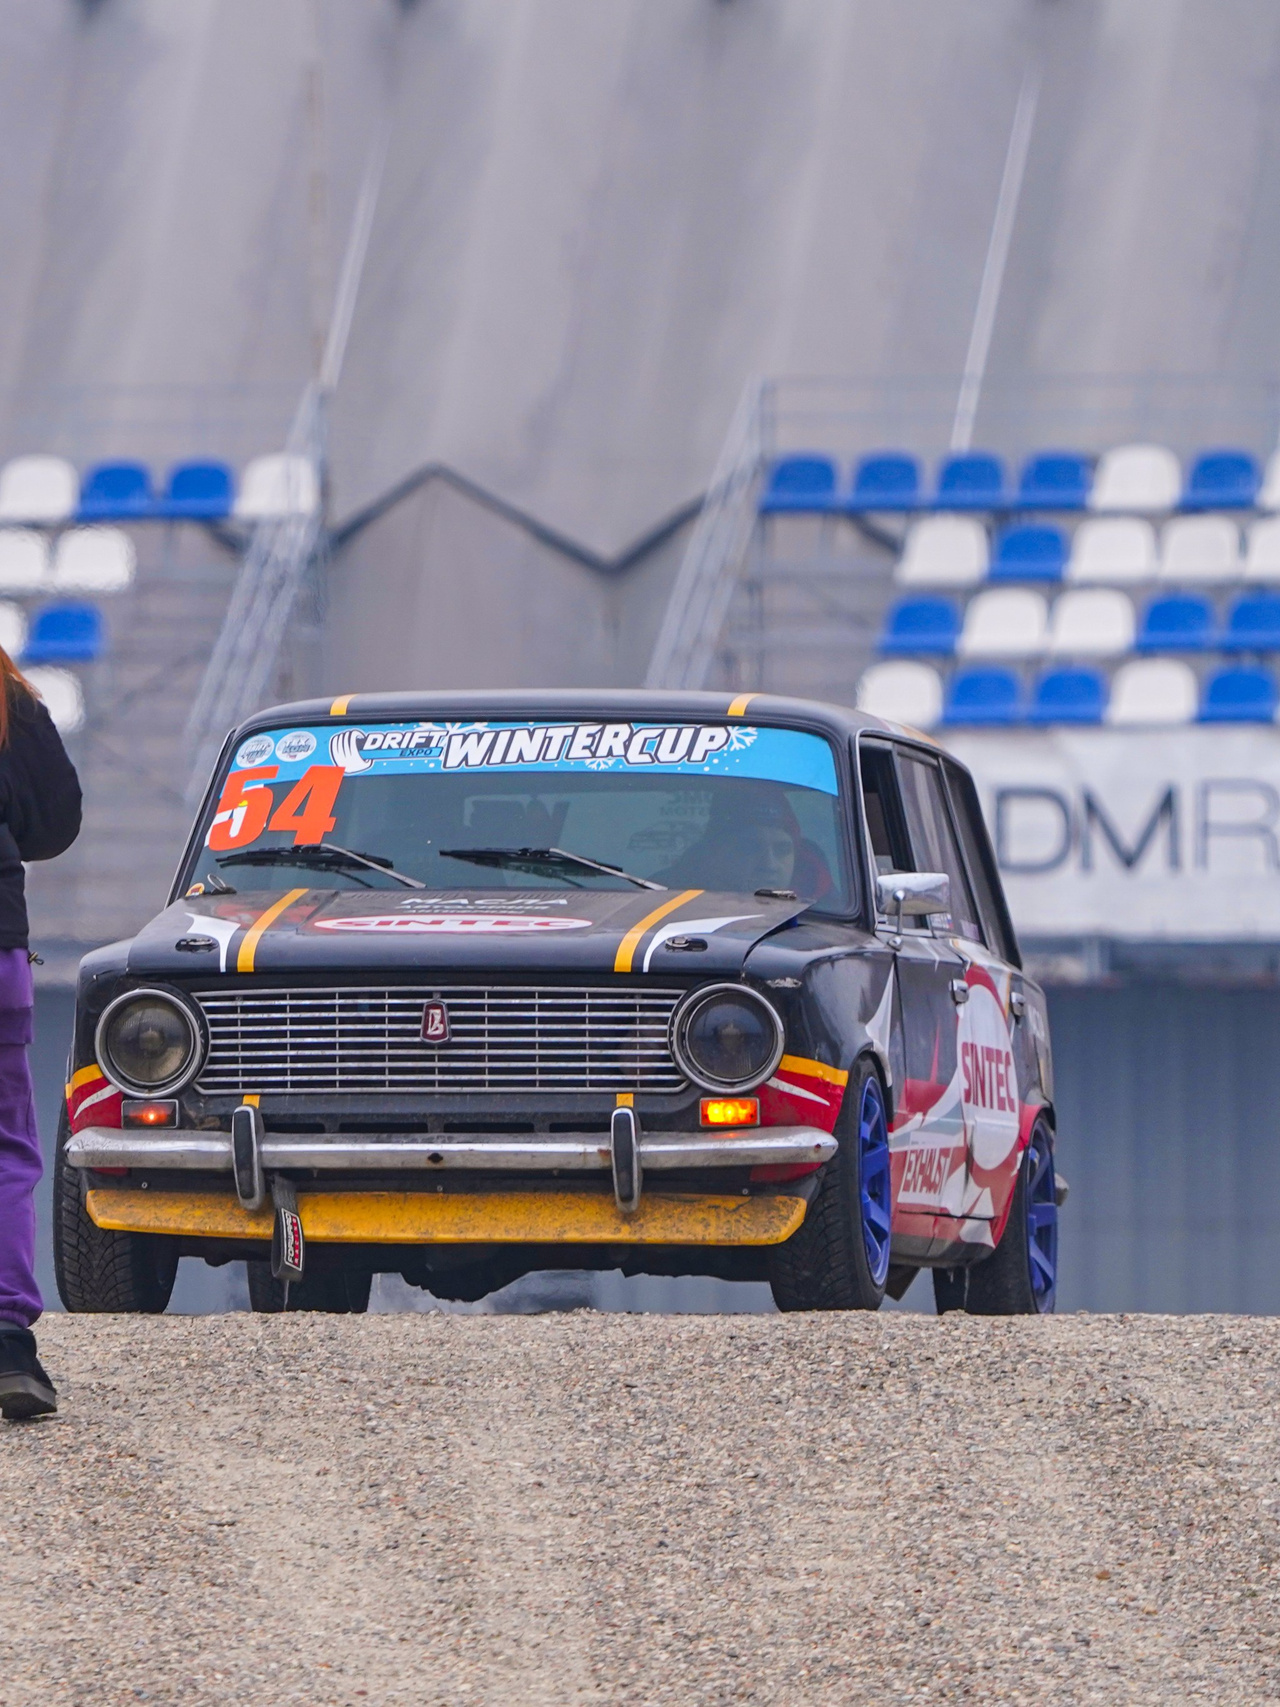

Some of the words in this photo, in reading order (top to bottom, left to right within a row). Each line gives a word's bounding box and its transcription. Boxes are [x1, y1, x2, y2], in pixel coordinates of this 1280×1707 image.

[362, 731, 448, 750] DRIFT
[399, 749, 433, 758] EXPO
[209, 765, 346, 852] 54
[335, 919, 574, 929] SINTEC
[960, 1040, 1017, 1113] SINTEC
[902, 1148, 952, 1196] EXHAUST
